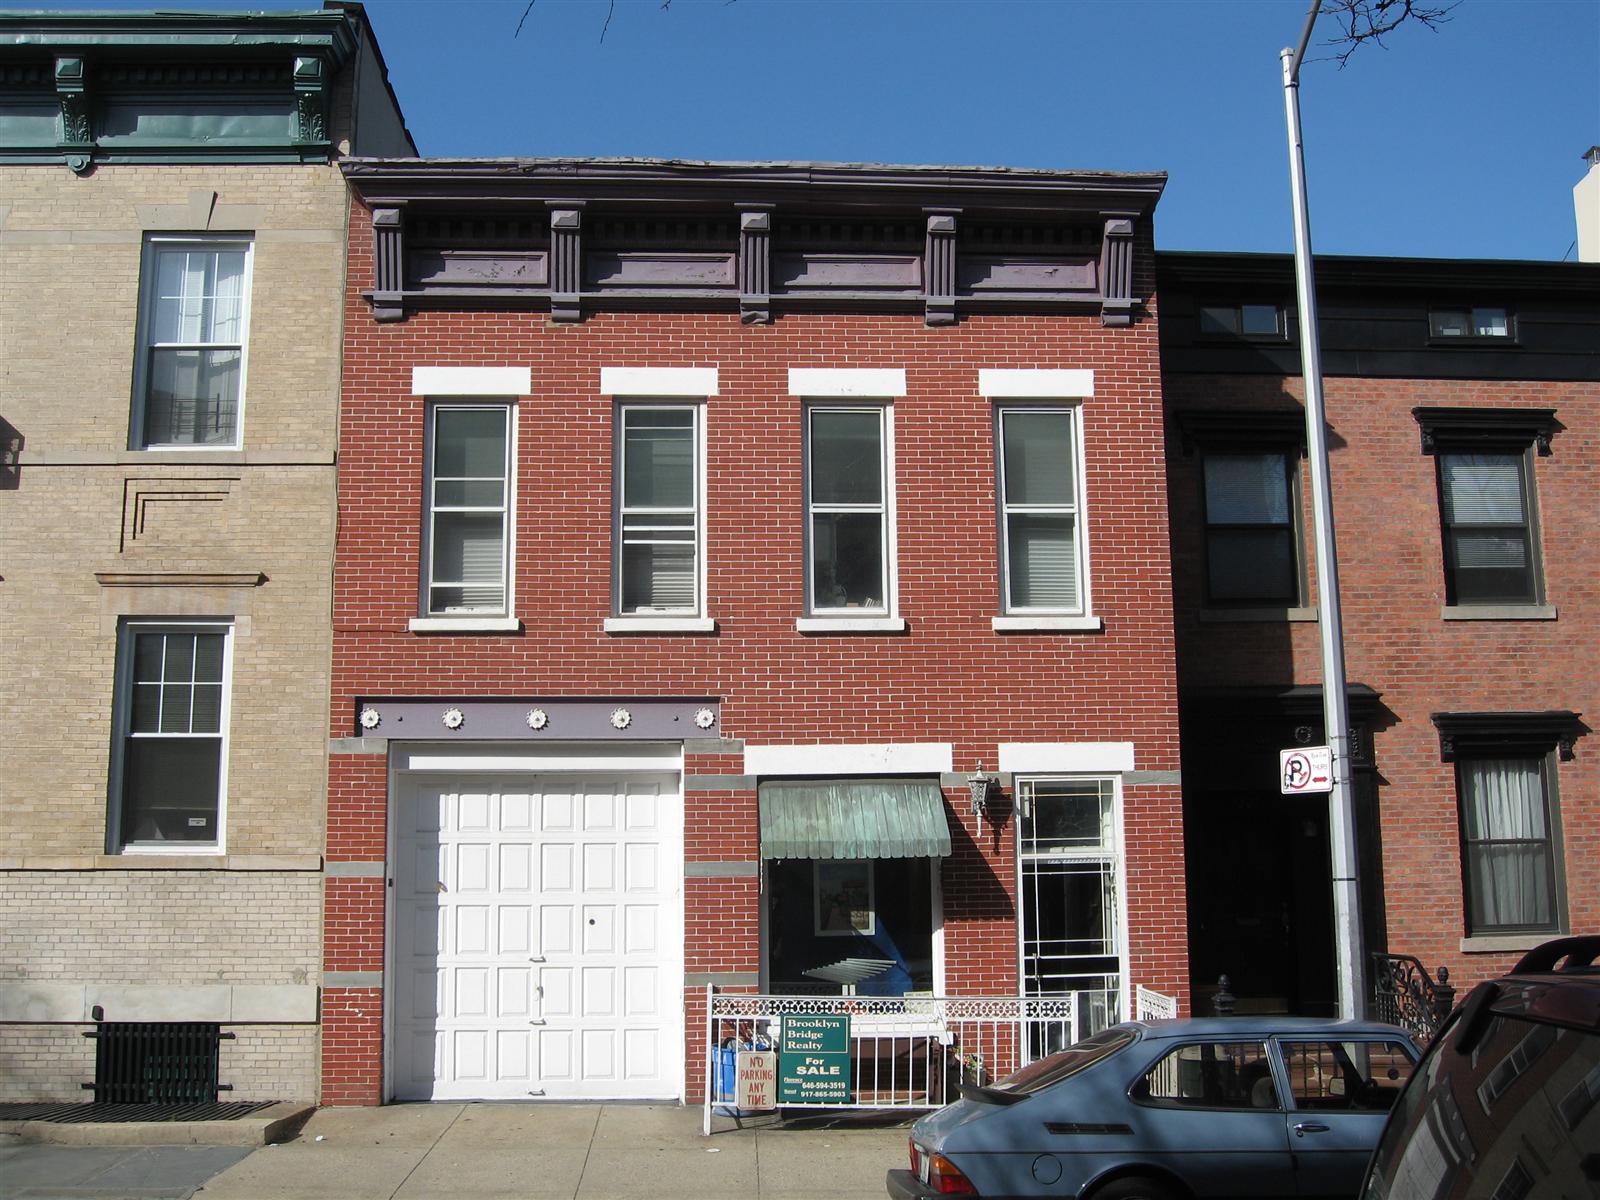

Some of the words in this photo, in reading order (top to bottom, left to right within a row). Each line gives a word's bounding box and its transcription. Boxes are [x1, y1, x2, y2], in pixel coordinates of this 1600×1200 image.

[787, 1019, 840, 1029] Brooklyn
[787, 1030, 824, 1039] Bridge
[787, 1041, 823, 1050] Realty
[750, 1056, 764, 1068] NO
[805, 1057, 825, 1065] For
[740, 1069, 773, 1080] PARKING
[796, 1066, 840, 1075] SALE
[749, 1083, 765, 1093] ANY
[747, 1095, 767, 1105] TIME
